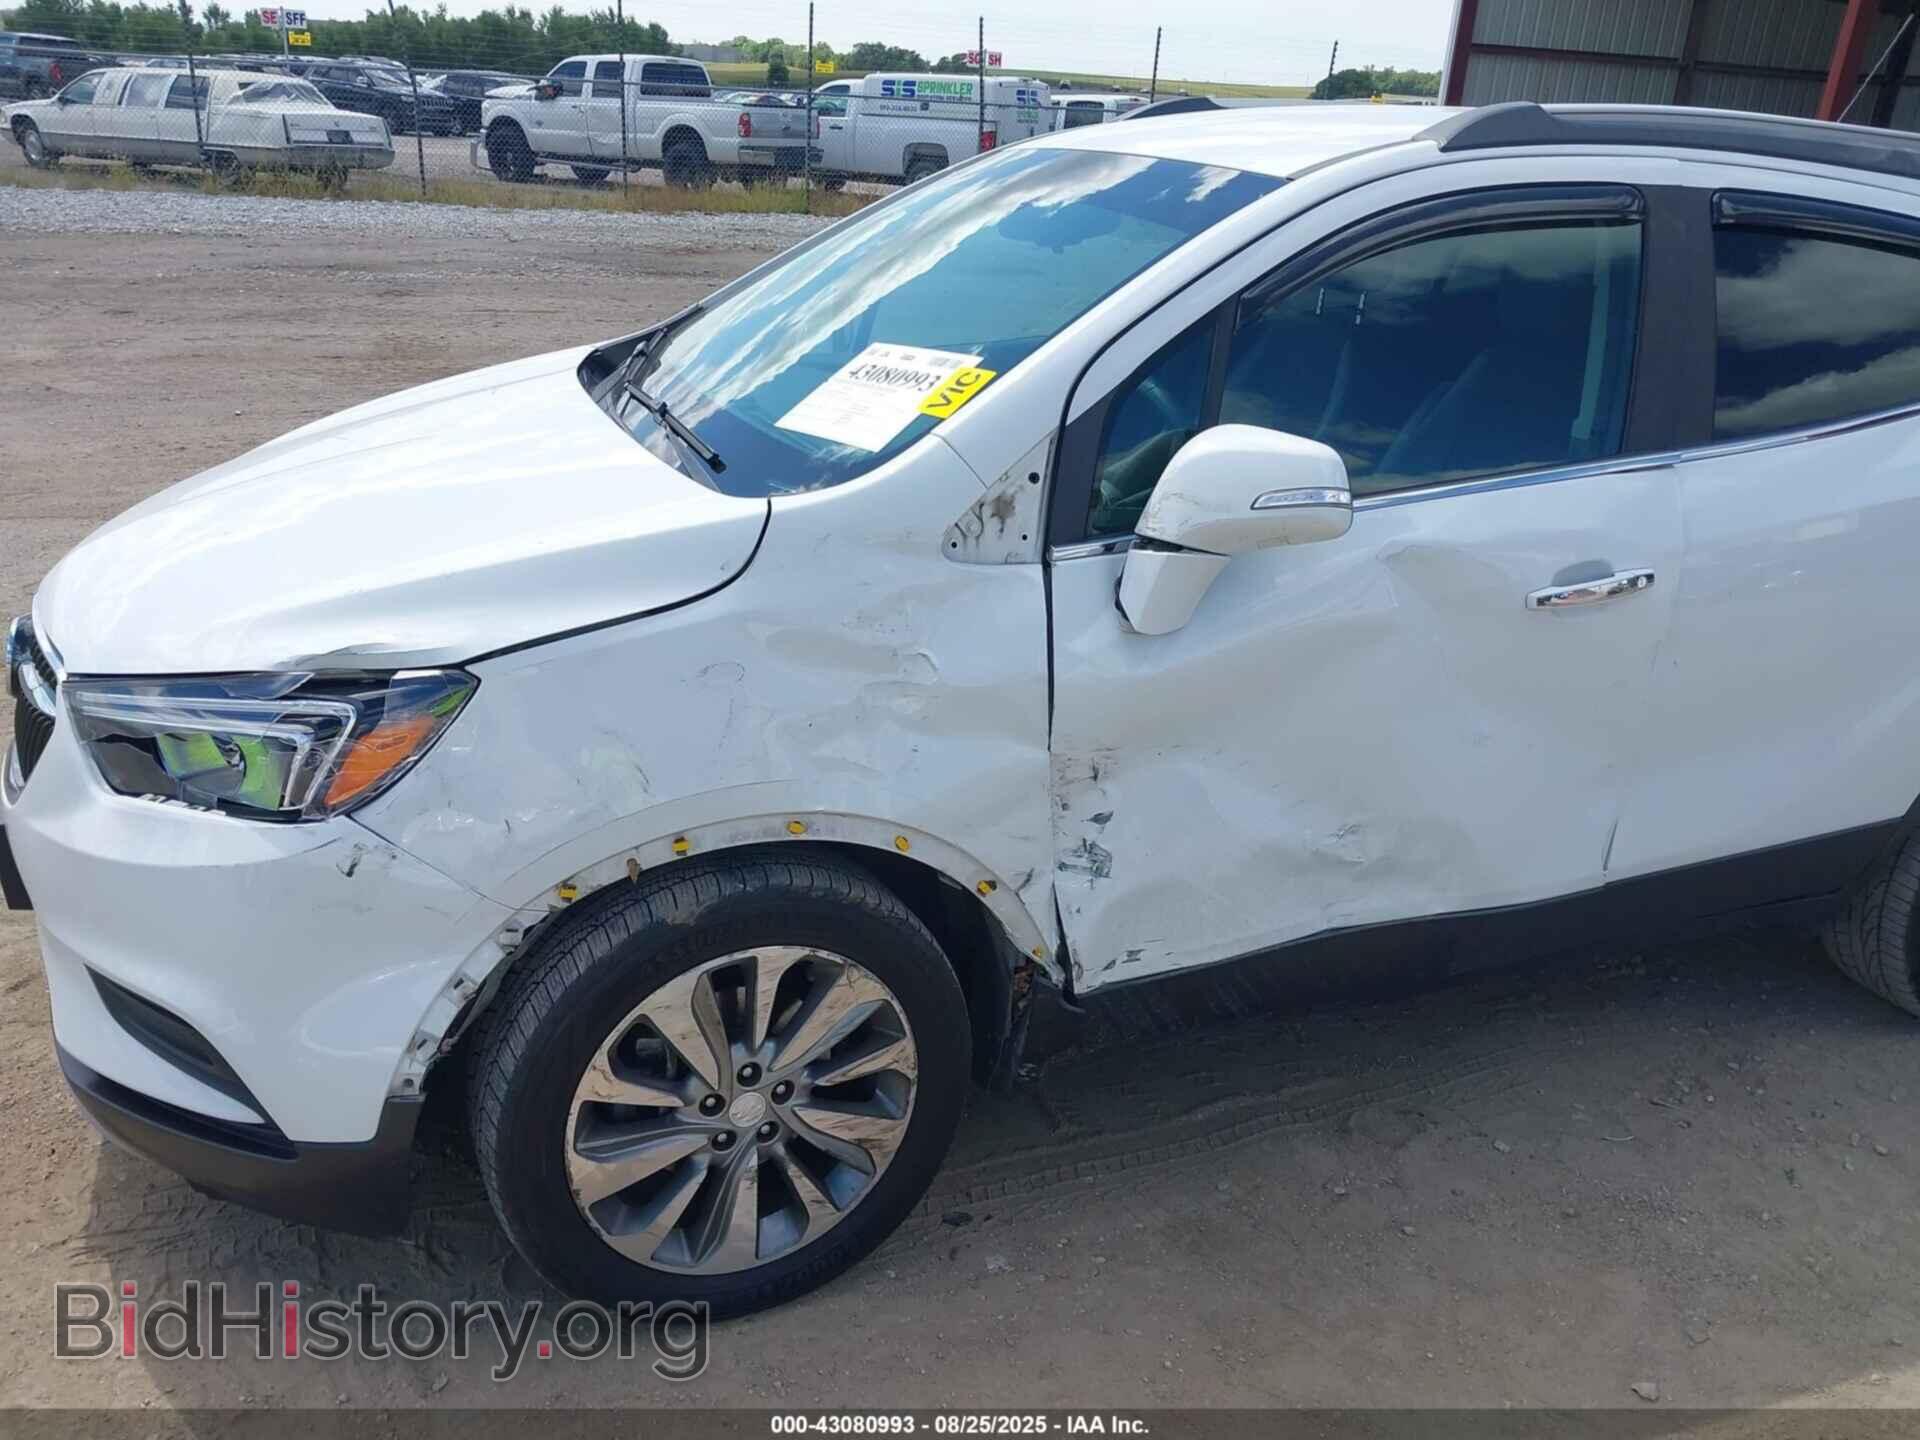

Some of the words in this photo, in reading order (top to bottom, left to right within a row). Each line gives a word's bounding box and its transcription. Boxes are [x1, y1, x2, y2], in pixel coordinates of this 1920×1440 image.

[262, 11, 277, 24] SE
[917, 81, 973, 95] SPRINKLER
[848, 363, 943, 391] 43080993
[927, 371, 982, 409] VIC
